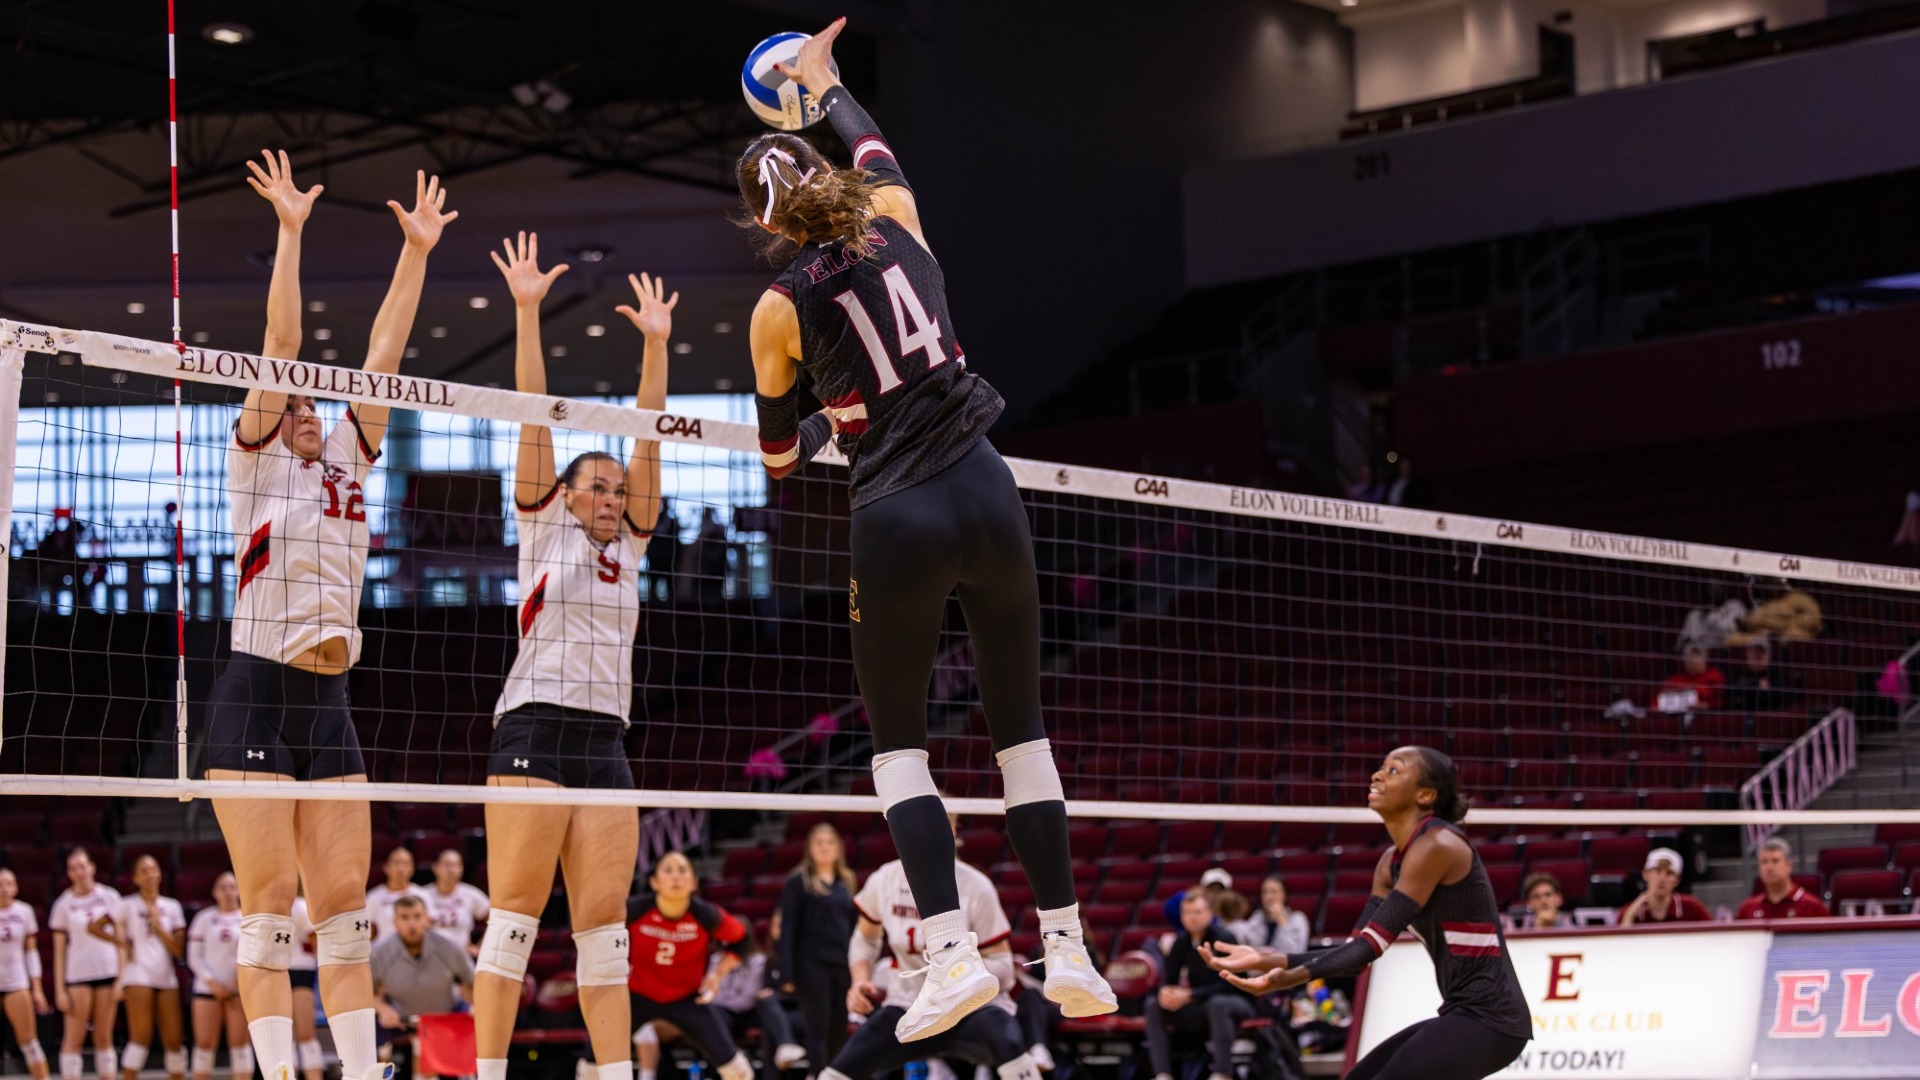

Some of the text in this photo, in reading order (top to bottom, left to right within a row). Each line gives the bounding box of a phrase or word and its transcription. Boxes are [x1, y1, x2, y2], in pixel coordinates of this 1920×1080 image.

[25, 327, 50, 338] Senoh
[833, 261, 947, 396] 14
[176, 348, 456, 407] ELON VOLLEYBALL
[655, 414, 702, 439] CAA
[1133, 476, 1169, 498] CAA
[322, 479, 366, 523] 12
[1229, 487, 1384, 525] ELON VOLLEYBALL
[1496, 522, 1523, 542] CAA
[1569, 532, 1690, 561] ELON VOLLEYBALL
[655, 941, 676, 966] 2
[1542, 953, 1584, 1003] E
[1590, 1011, 1664, 1033] CLUB
[1539, 1050, 1627, 1071] TODAY!
